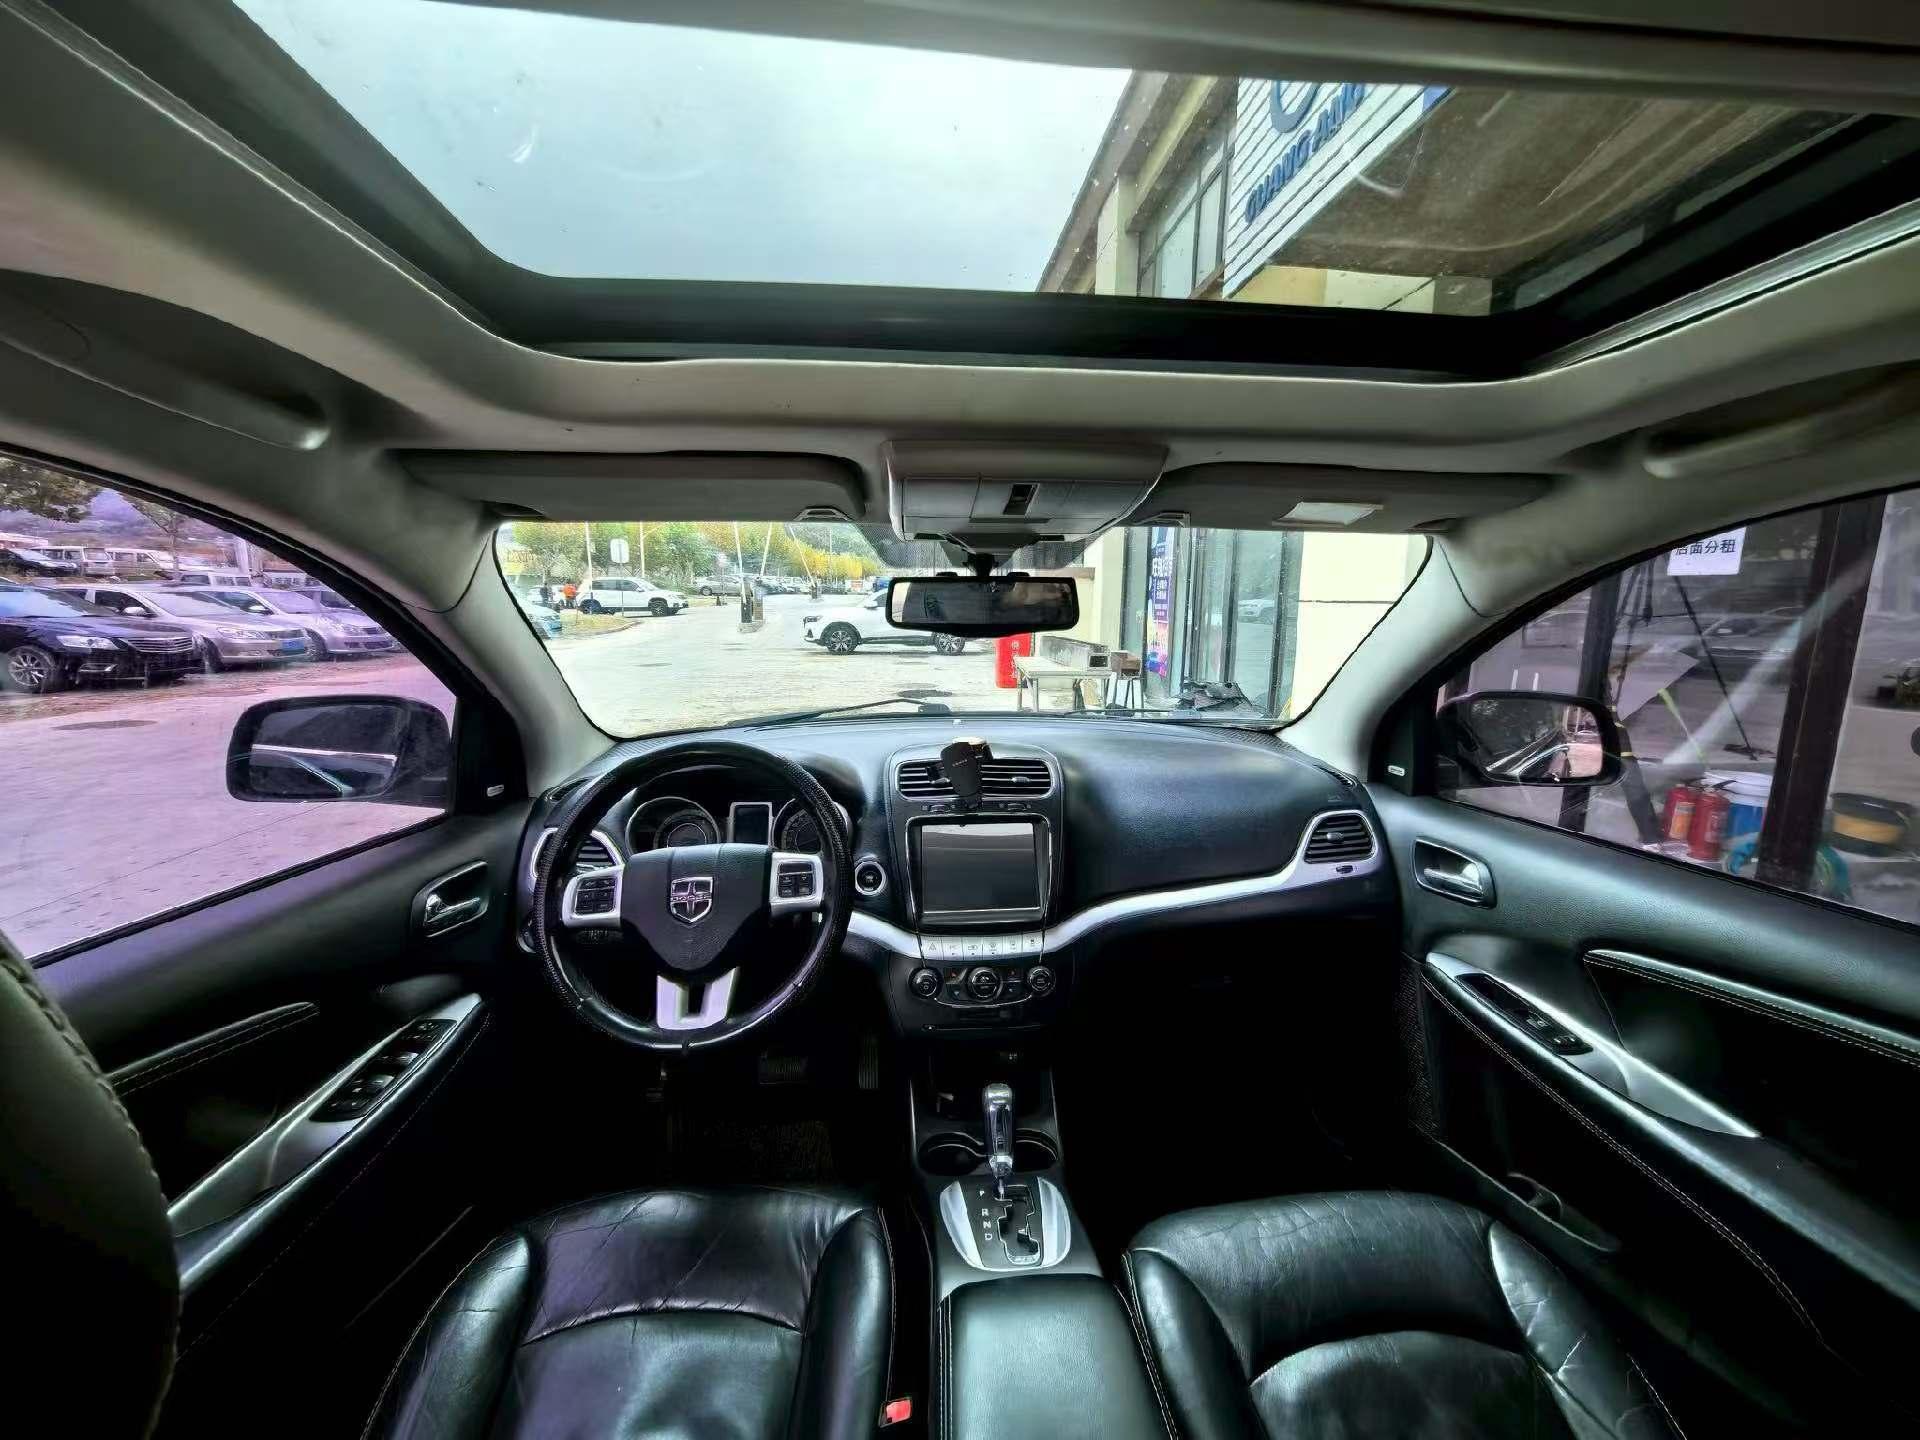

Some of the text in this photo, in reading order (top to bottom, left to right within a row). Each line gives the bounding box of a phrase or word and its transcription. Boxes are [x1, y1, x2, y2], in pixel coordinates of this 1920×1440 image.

[981, 1208, 989, 1217] R
[983, 1220, 991, 1229] N
[984, 1233, 993, 1241] D
